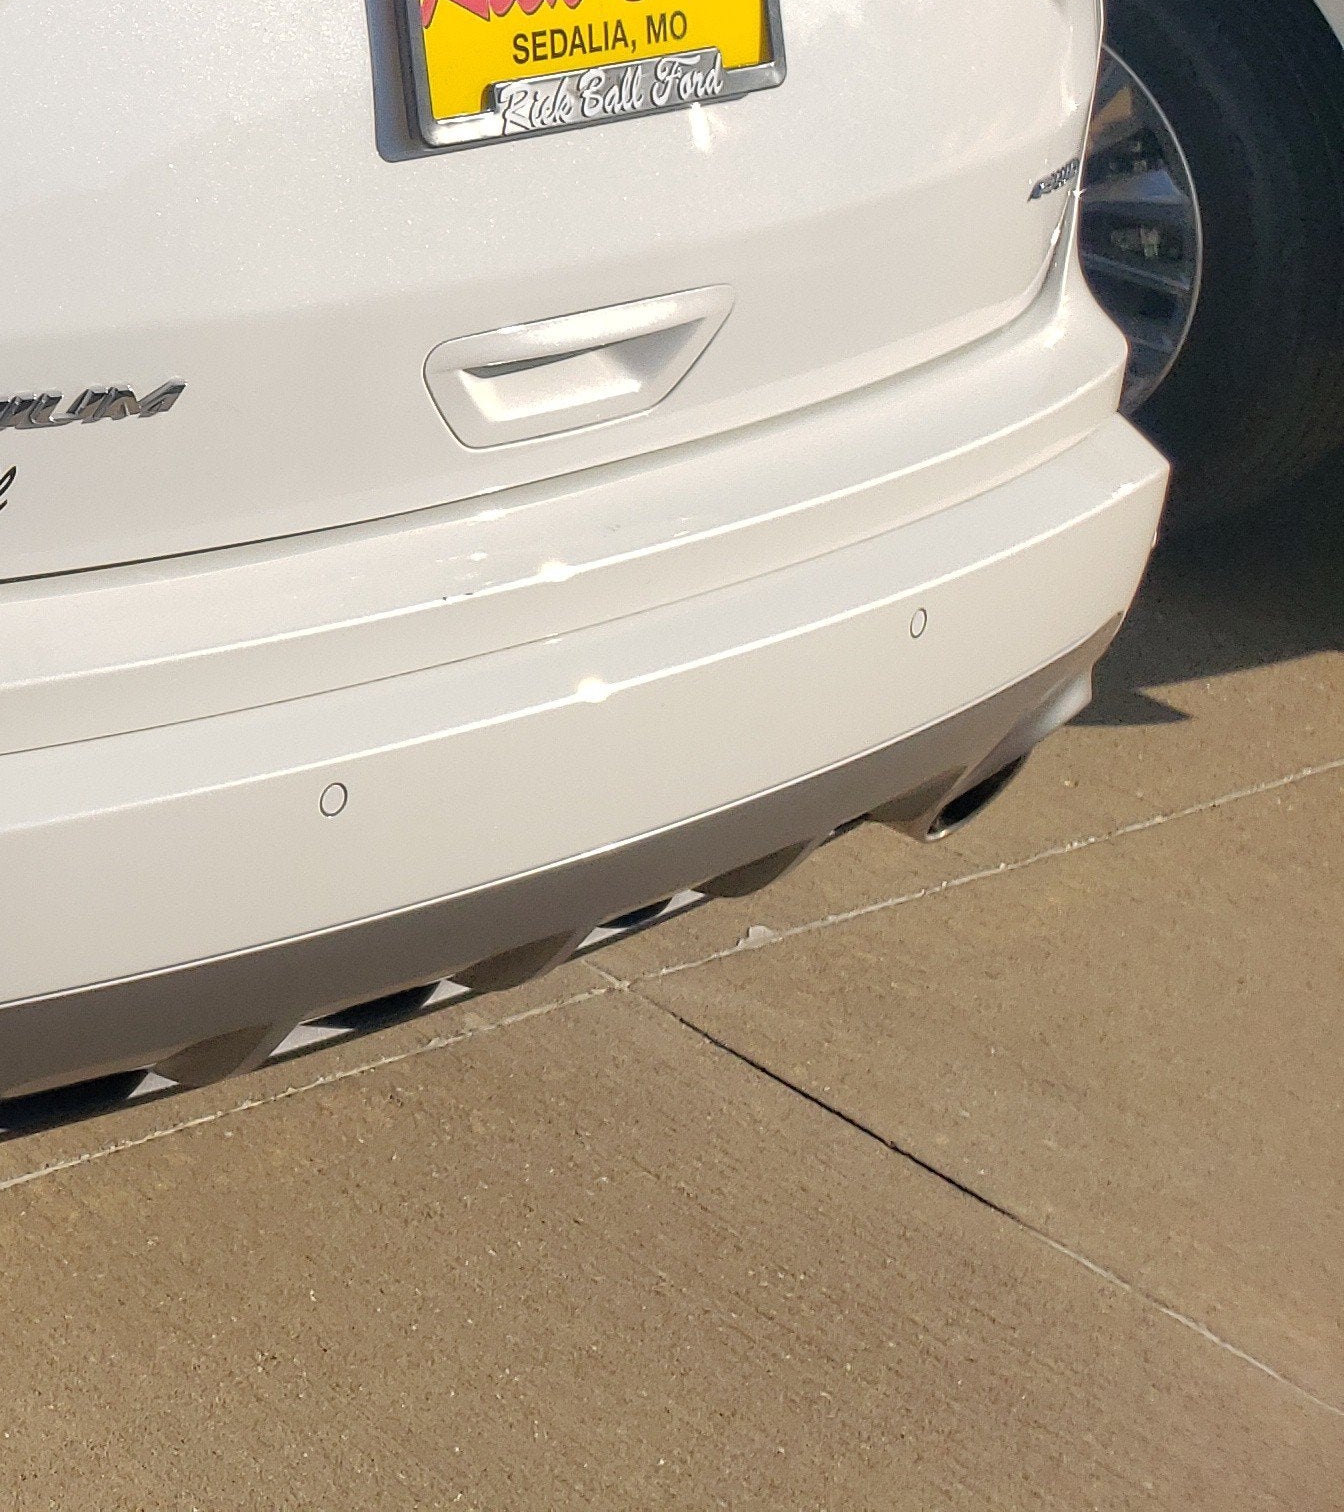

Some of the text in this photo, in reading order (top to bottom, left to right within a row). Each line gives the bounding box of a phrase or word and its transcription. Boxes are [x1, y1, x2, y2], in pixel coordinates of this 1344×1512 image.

[513, 10, 687, 64] SEDALIA, MO
[498, 52, 724, 136] Rick Ball Ford
